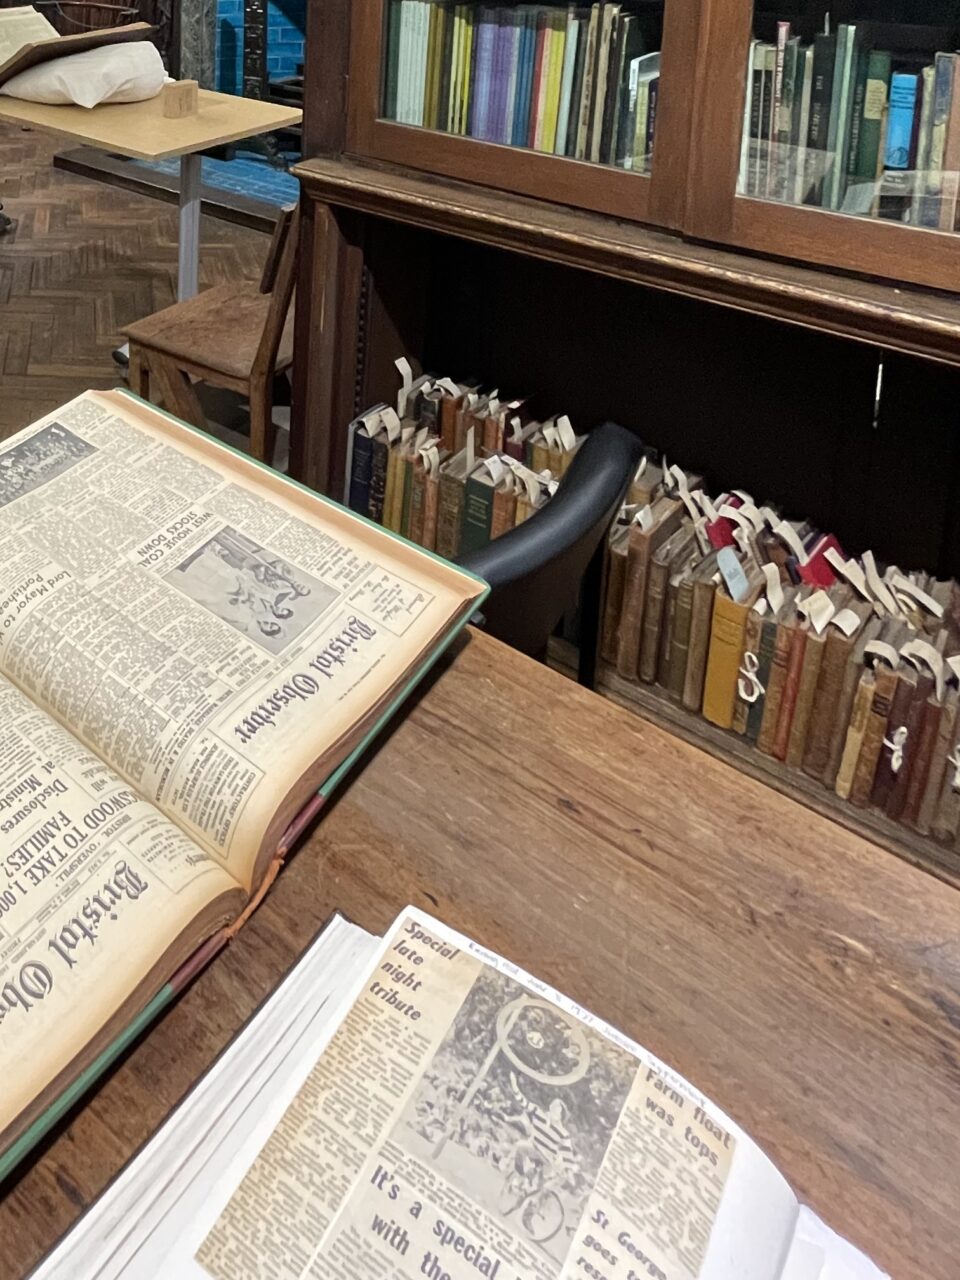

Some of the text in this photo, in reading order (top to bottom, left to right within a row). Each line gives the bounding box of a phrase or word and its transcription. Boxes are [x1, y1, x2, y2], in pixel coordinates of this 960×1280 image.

[136, 509, 197, 558] STOCKS DOWN
[137, 508, 214, 570] WEST HOUSE COAL
[12, 583, 48, 613] Mayor
[46, 568, 71, 590] Lord
[1, 613, 15, 628] to
[308, 610, 376, 682] Bristol
[232, 666, 320, 745] Observer
[39, 759, 56, 776] at
[79, 784, 139, 834] GSWOOD
[100, 812, 132, 839] BRISTOL
[61, 824, 87, 851] TO
[22, 842, 68, 886] TAKE
[43, 856, 151, 972] Bristol
[392, 937, 426, 967] late
[402, 919, 460, 962] Special
[379, 959, 424, 993] night
[367, 979, 424, 1023] tribute
[644, 1068, 686, 1108] Farm
[690, 1105, 735, 1148] float
[643, 1095, 721, 1167] was tops
[369, 1213, 412, 1256] with
[370, 1164, 502, 1280] It's a special
[591, 1209, 609, 1230] St
[581, 1233, 619, 1266] goes
